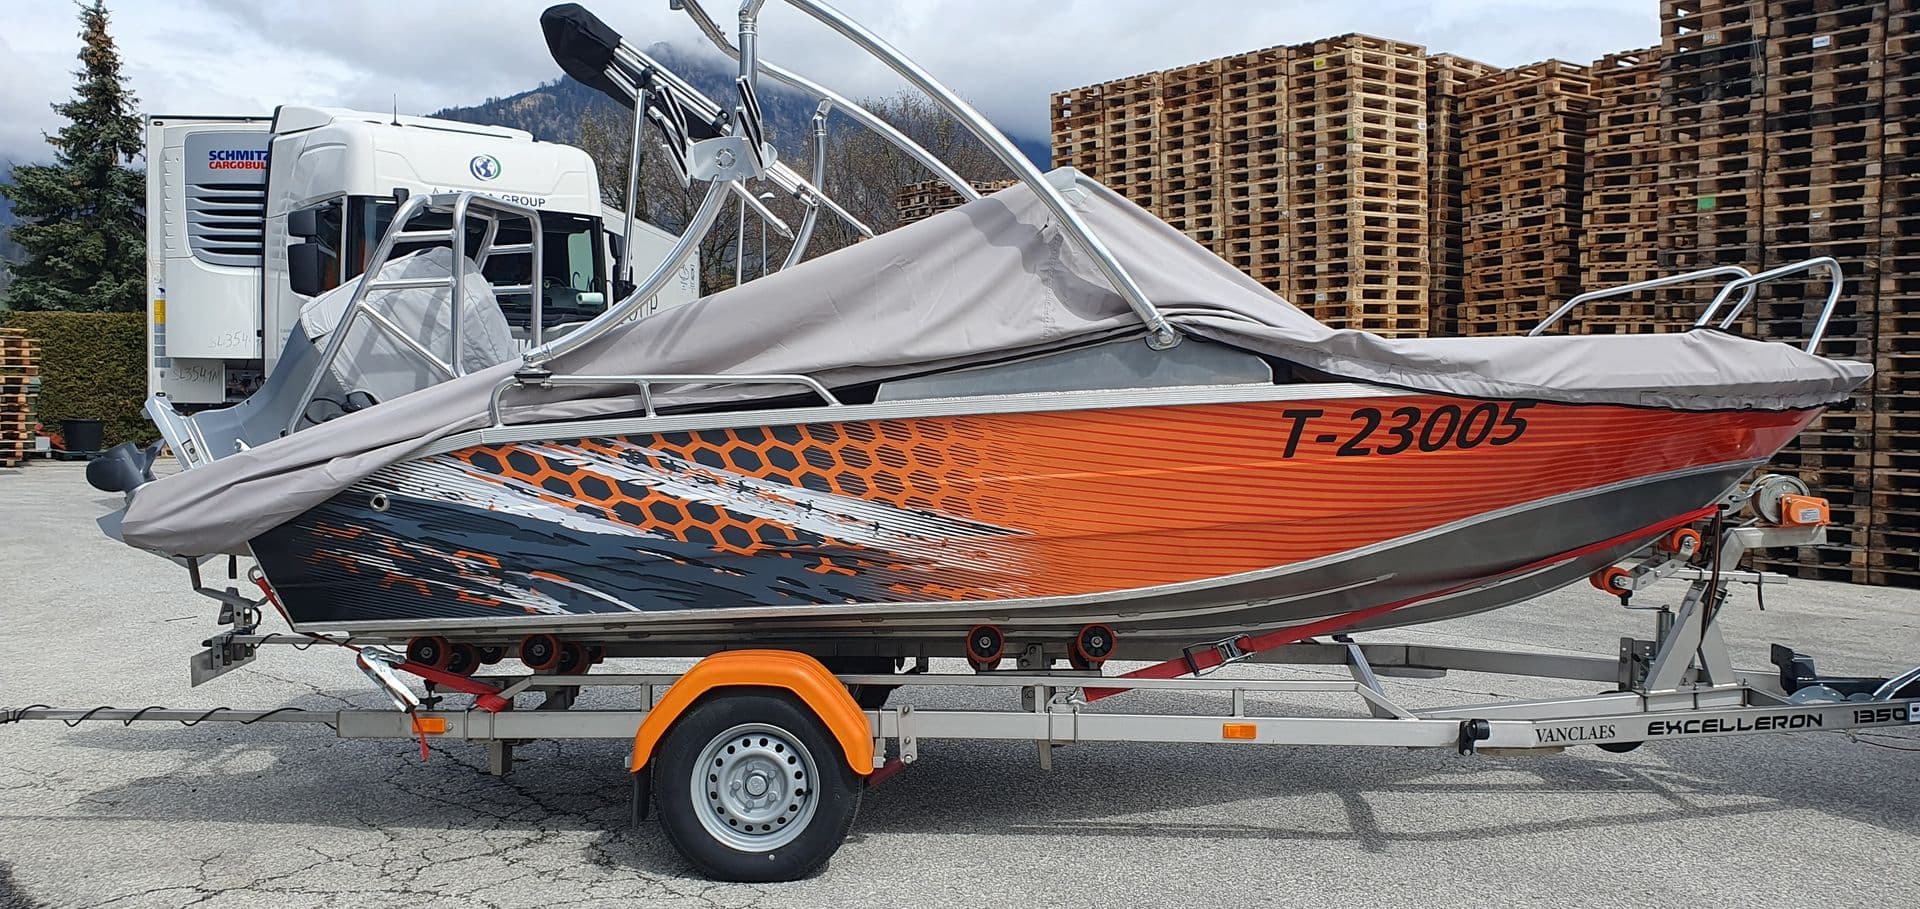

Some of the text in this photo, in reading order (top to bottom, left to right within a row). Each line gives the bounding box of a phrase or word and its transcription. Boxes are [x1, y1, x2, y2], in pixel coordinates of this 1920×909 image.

[501, 194, 546, 208] GROUP
[1281, 401, 1537, 459] T-23005
[1535, 724, 1616, 743] VANCLAES
[1647, 713, 1823, 736] EXCELLERON
[1853, 707, 1907, 724] 1350
